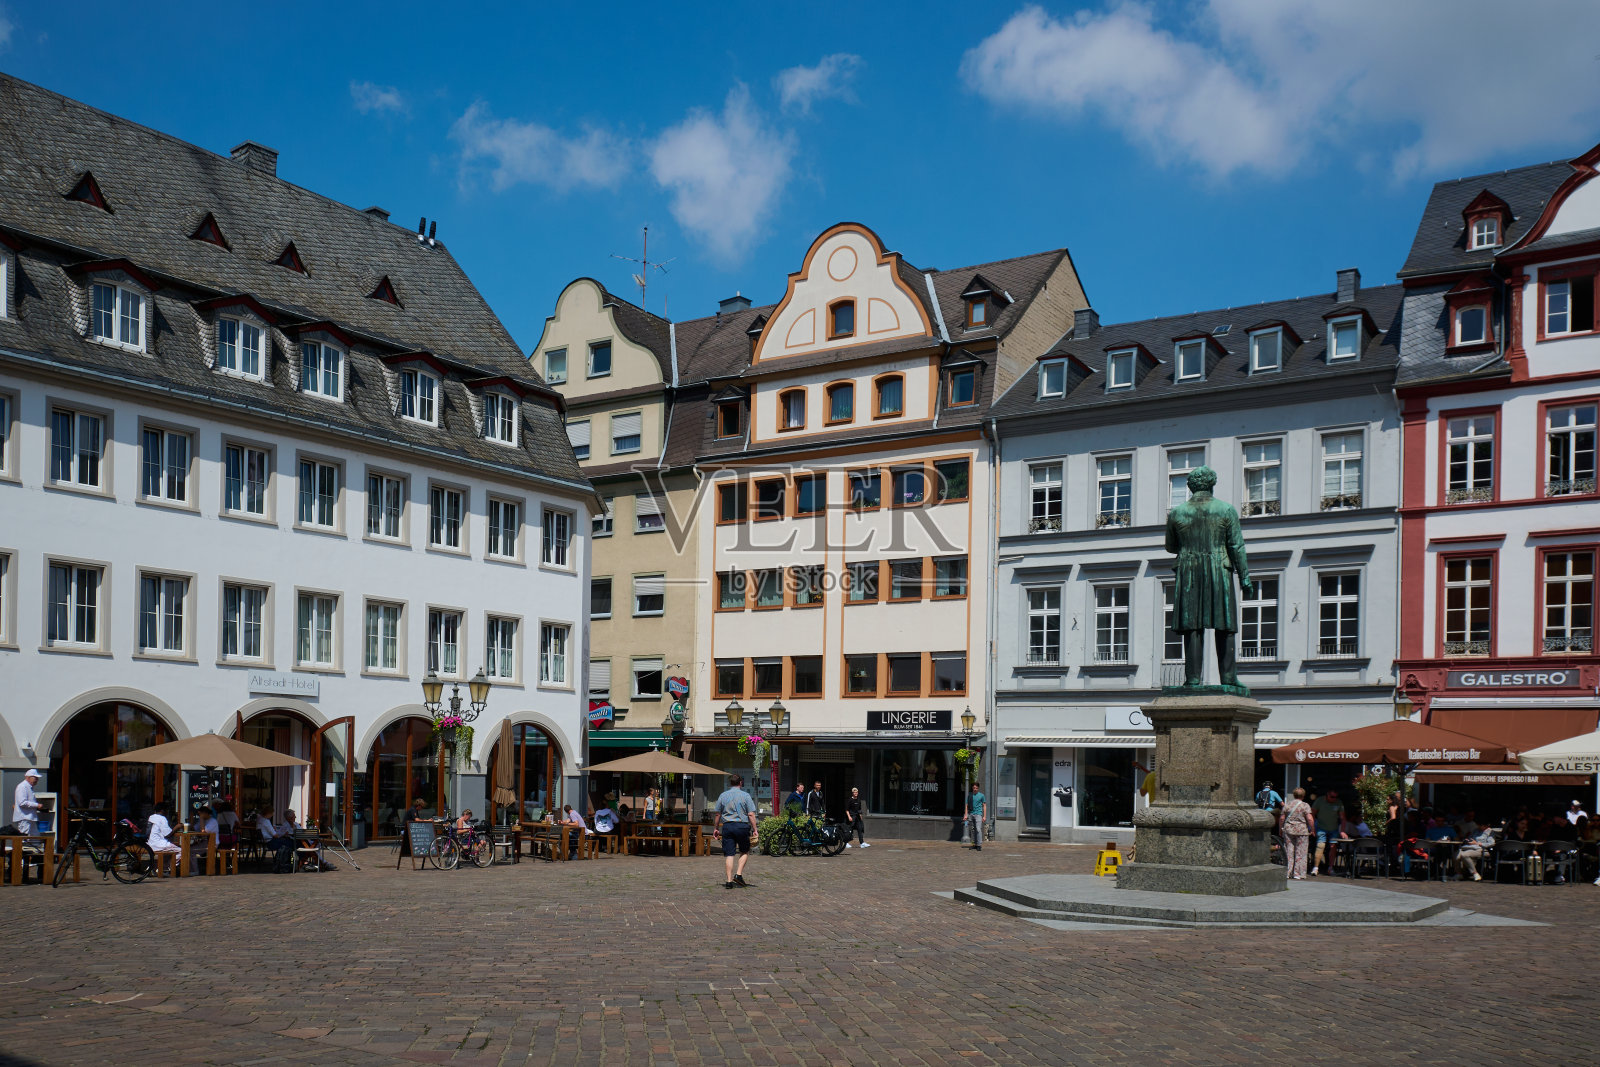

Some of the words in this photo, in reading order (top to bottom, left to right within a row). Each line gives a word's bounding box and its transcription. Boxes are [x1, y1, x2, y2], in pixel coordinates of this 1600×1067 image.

[250, 675, 315, 690] Altstadt-Hotel
[1460, 671, 1567, 685] GALESTRO
[881, 711, 937, 724] LINGERIE
[1307, 751, 1360, 759] GALESTRO
[1408, 748, 1442, 760] Italienische
[1442, 748, 1469, 761] Espresso
[1469, 748, 1481, 760] Bar
[1463, 775, 1497, 783] ITALIENISCHE
[1497, 775, 1525, 783] ESPRESSO
[1527, 775, 1539, 783] BAR
